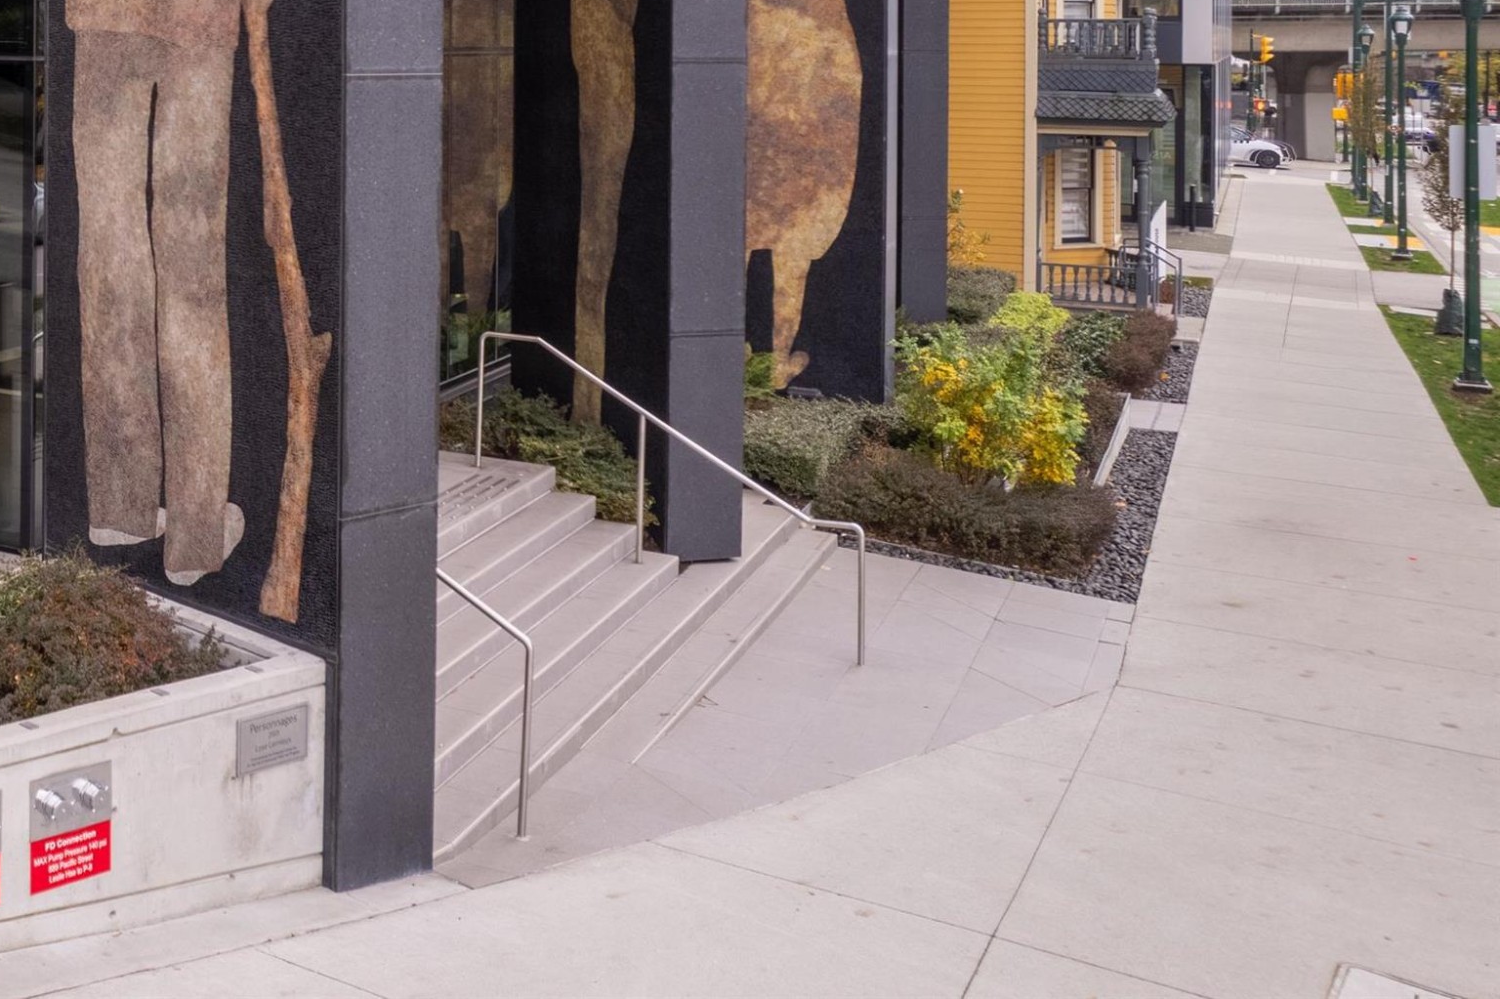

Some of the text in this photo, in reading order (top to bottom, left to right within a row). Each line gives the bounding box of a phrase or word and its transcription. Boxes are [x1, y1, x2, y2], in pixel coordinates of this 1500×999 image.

[44, 830, 97, 852] FD Connection
[33, 855, 48, 868] MAX
[47, 852, 64, 864] Pump
[64, 845, 88, 858] Pressure
[59, 858, 77, 870] Pacific
[77, 852, 94, 865] Street
